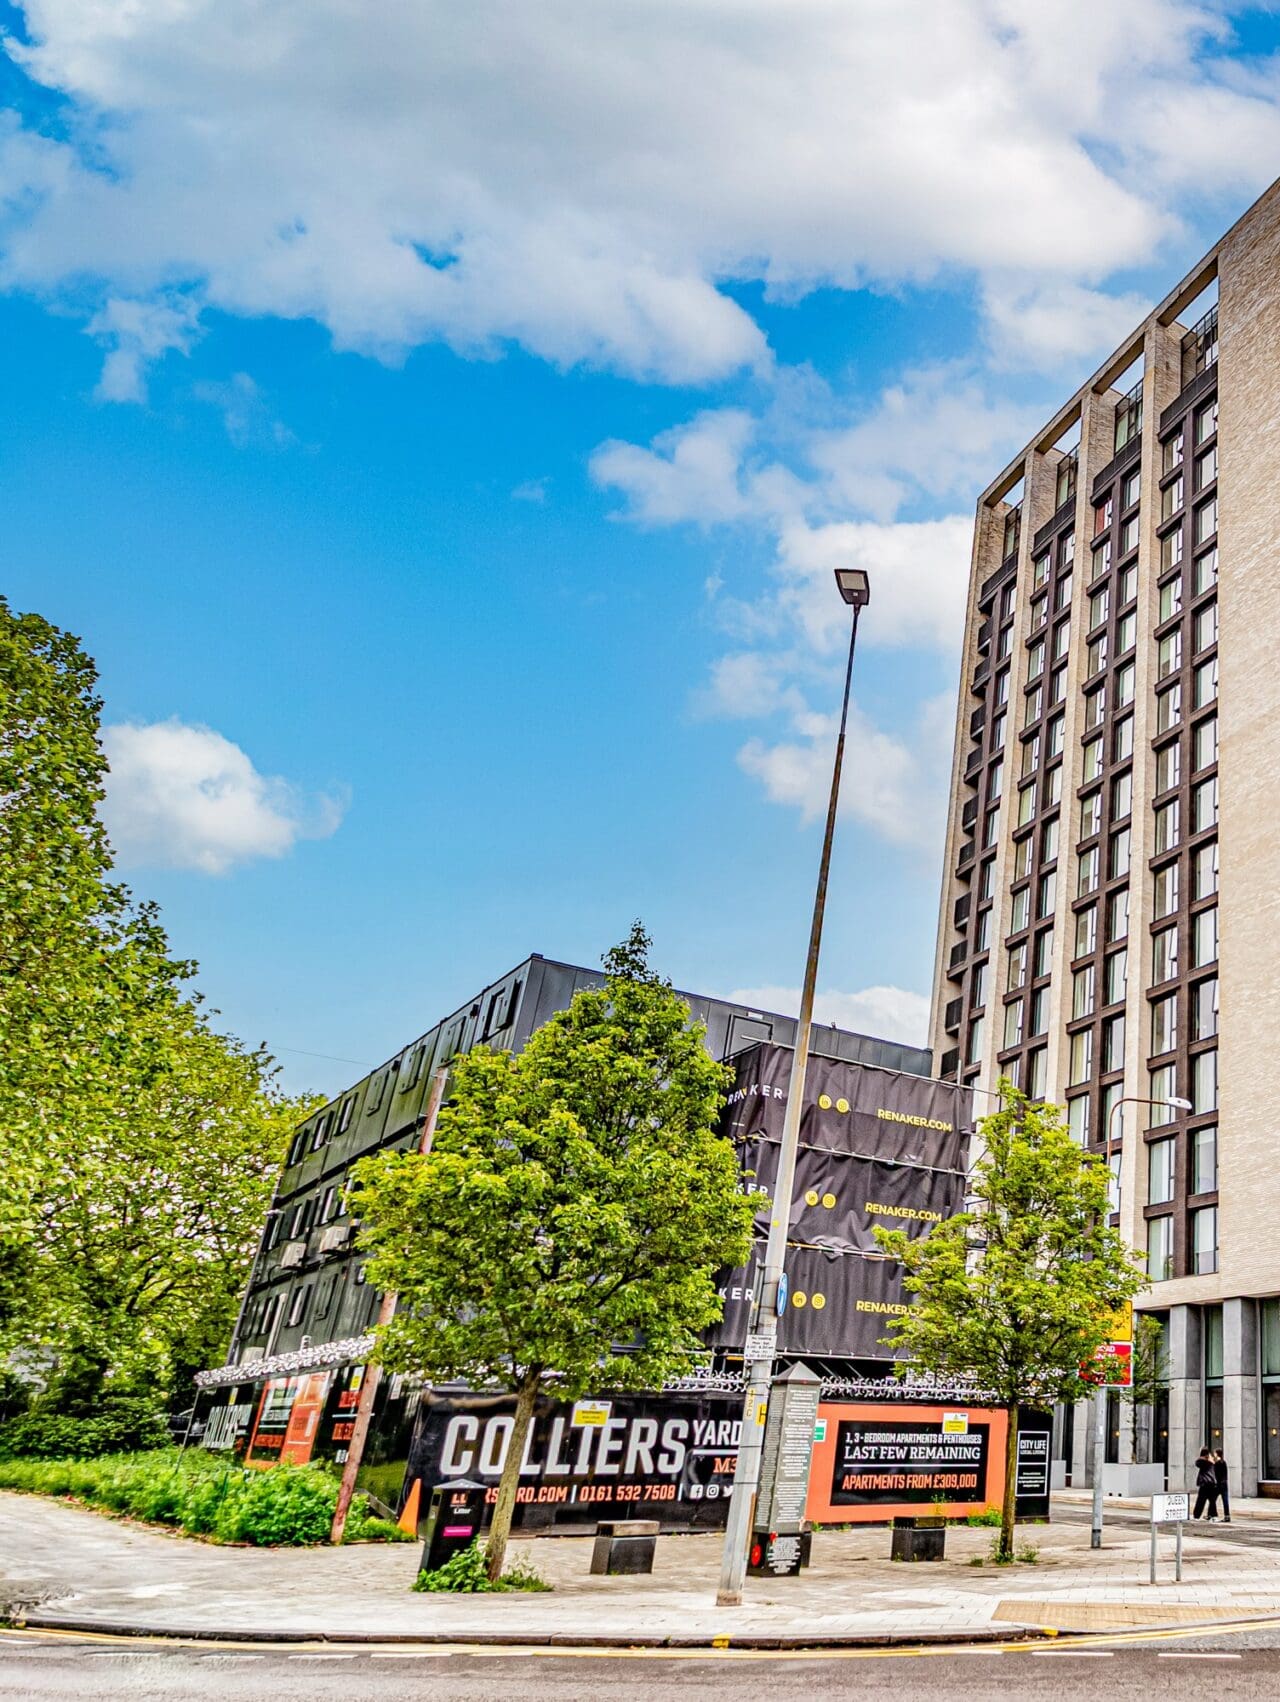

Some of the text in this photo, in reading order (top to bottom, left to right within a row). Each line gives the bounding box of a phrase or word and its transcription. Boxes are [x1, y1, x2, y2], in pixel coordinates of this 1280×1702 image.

[877, 1108, 953, 1132] RENAKER.COM
[864, 1202, 942, 1222] RENAKER.COM
[439, 1415, 743, 1476] COLLIERS YARD
[864, 1433, 896, 1443] BEDROOM
[897, 1433, 937, 1444] APARTMENTS
[943, 1434, 983, 1444] PENTHOUSES
[1020, 1440, 1047, 1450] CITY LIFE
[844, 1446, 981, 1460] LAST FEW REMAINING
[842, 1473, 977, 1490] APARTMENTS FROM £309,000
[580, 1486, 612, 1501] 0161
[616, 1485, 641, 1501] 532
[644, 1484, 676, 1500] 7508
